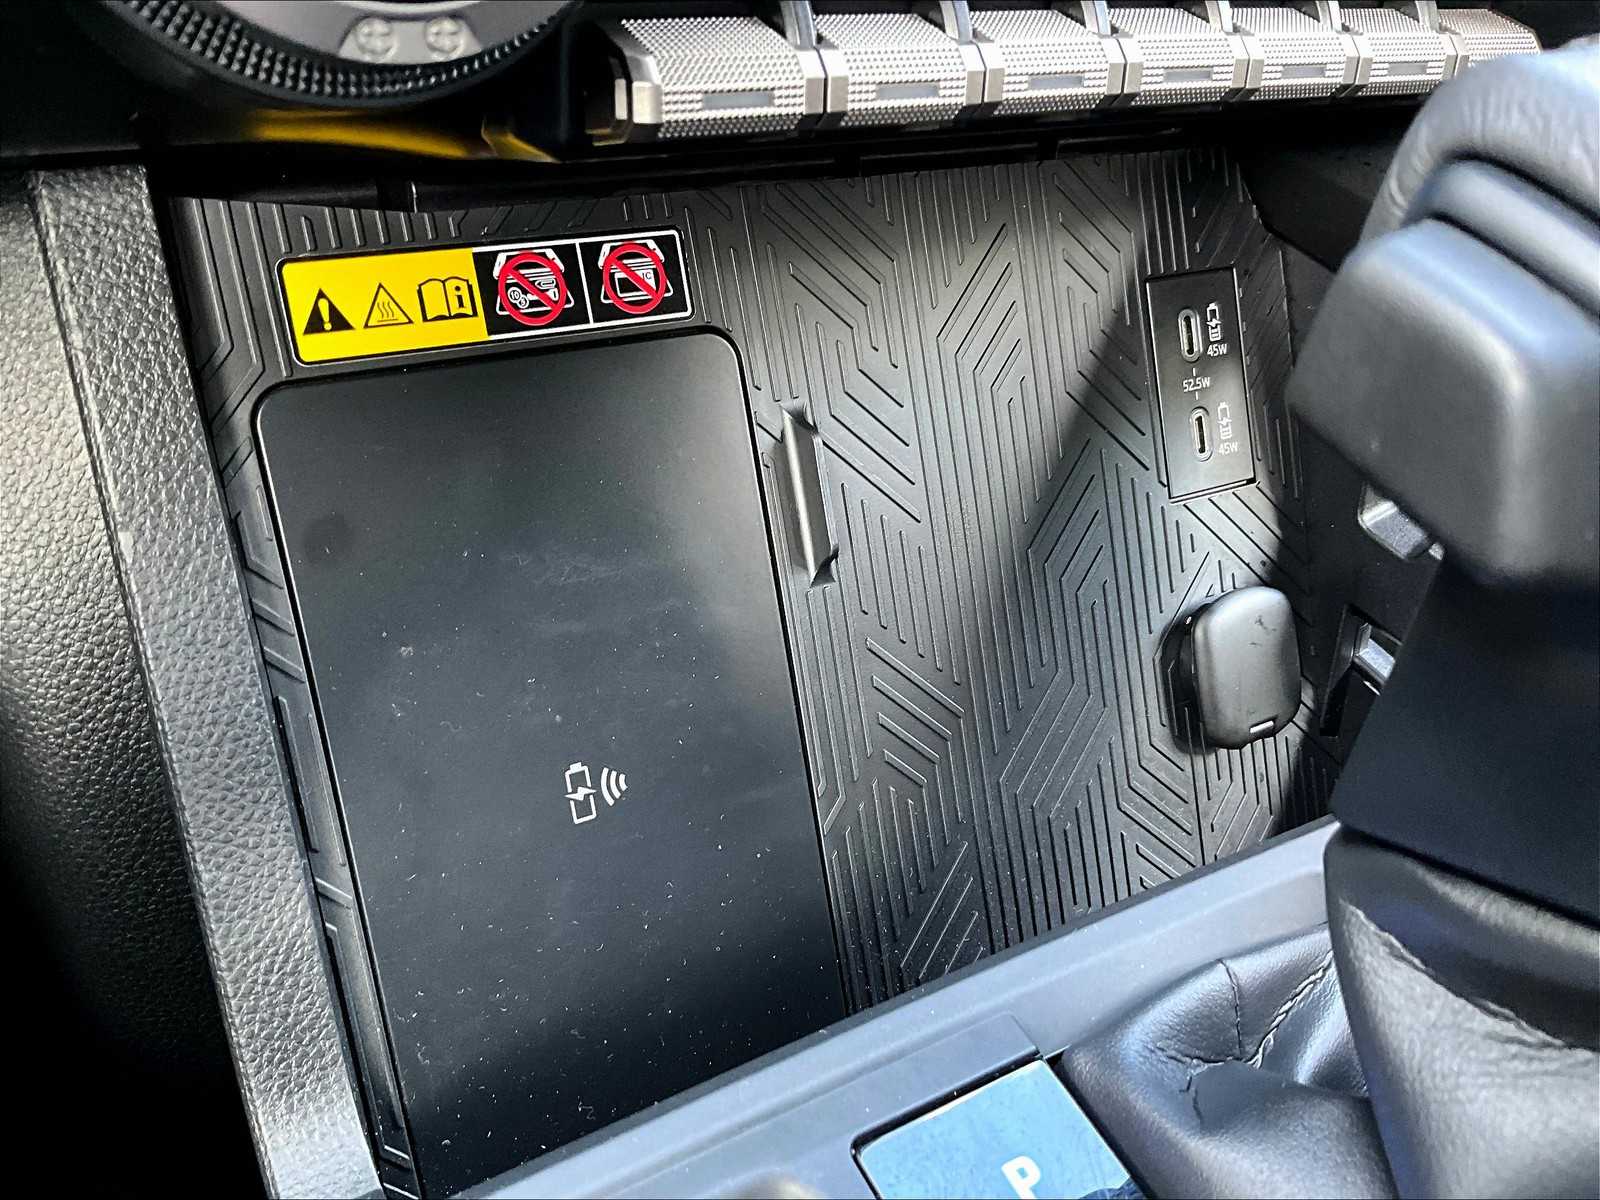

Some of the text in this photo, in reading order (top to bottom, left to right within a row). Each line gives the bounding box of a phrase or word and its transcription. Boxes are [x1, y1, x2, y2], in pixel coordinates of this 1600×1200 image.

[1207, 343, 1228, 357] 45W
[1183, 376, 1211, 392] 52.5W
[1218, 441, 1239, 455] 45W
[1001, 1155, 1041, 1200] P
